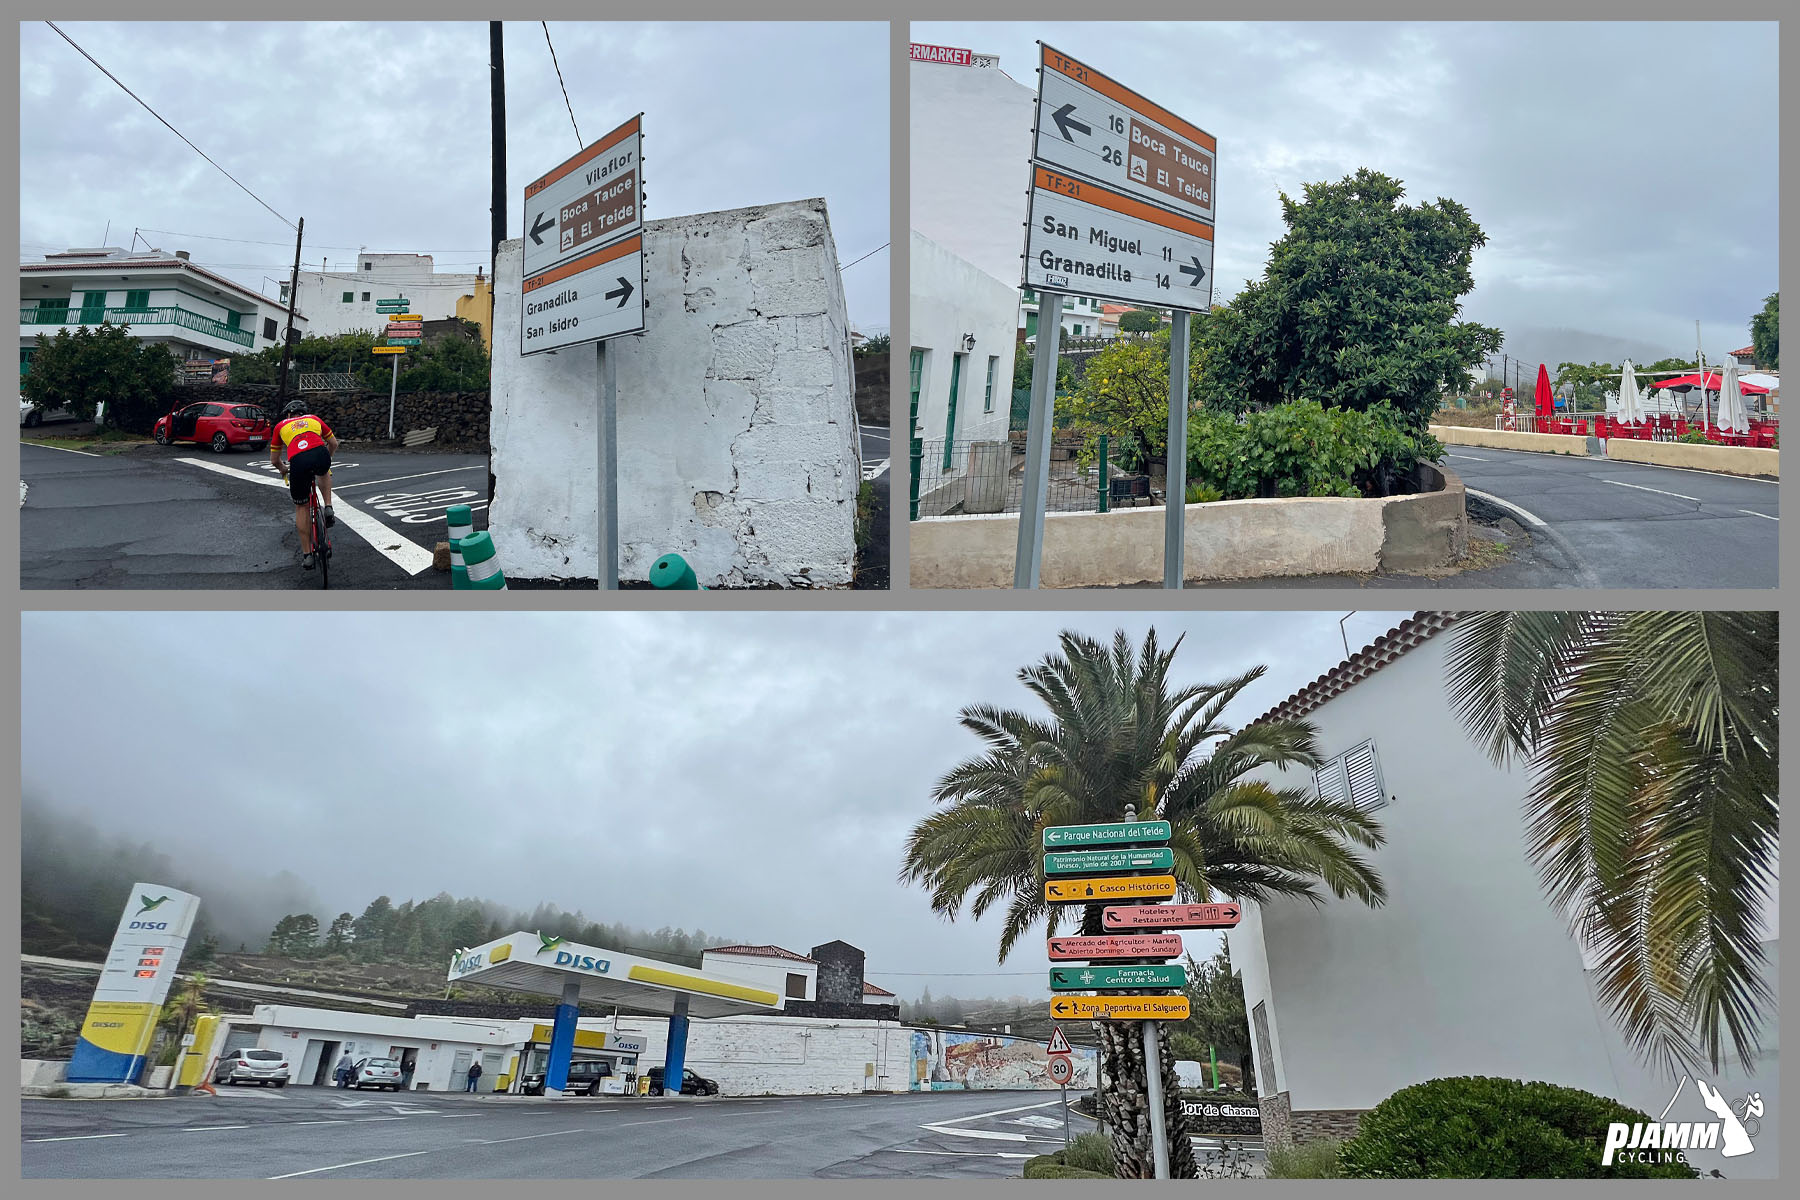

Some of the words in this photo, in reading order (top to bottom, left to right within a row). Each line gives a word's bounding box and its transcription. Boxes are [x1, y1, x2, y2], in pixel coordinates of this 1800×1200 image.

[1054, 55, 1089, 82] TF-21
[1108, 114, 1125, 135] 16
[1132, 125, 1166, 155] Boca
[1173, 145, 1209, 176] Tauce
[585, 151, 633, 186] Vilaflor
[1102, 145, 1122, 167] 26
[1156, 168, 1170, 188] El
[1176, 175, 1209, 203] Teide
[529, 178, 547, 195] TF-21
[1046, 174, 1081, 196] TF-21
[561, 201, 588, 223] Boca
[594, 177, 633, 206] Tauce
[581, 222, 593, 238] El
[598, 204, 634, 230] Teide
[1042, 215, 1079, 240] San
[1089, 226, 1142, 256] Miguel
[1162, 246, 1172, 262] 11
[1039, 249, 1132, 283] Granadilla
[1155, 272, 1171, 290] 14
[527, 277, 545, 289] TF-21
[526, 289, 578, 316] Granadilla
[526, 324, 544, 340] San
[549, 315, 579, 334] Isidro
[1063, 831, 1090, 842] Parque
[1092, 828, 1126, 839] Nacional
[1127, 827, 1141, 837] del
[1142, 827, 1164, 836] Teide
[1052, 855, 1086, 863] Patrimonio
[1086, 853, 1110, 862] Natural
[1111, 853, 1120, 861] de
[1120, 852, 1127, 860] la
[1128, 851, 1164, 860] Humanidad
[1082, 861, 1099, 869] junio
[1100, 859, 1109, 867] de
[1110, 859, 1126, 867] 2007
[1099, 884, 1126, 893] Casco
[1128, 882, 1171, 891] Histórico
[1132, 916, 1184, 924] Restaurantes
[1095, 947, 1125, 955] Domingo
[1151, 946, 1177, 954] Sunday
[1105, 976, 1135, 984] Centro
[1148, 975, 1170, 983] Salud
[1081, 1003, 1100, 1012] Zona
[1104, 1003, 1141, 1013] Deportiva
[1143, 1003, 1151, 1012] El
[1152, 1003, 1187, 1013] Salguero
[1053, 1064, 1067, 1075] 30
[1180, 1100, 1203, 1116] lor
[1203, 1104, 1220, 1117] de
[1220, 1104, 1260, 1118] Chasna
